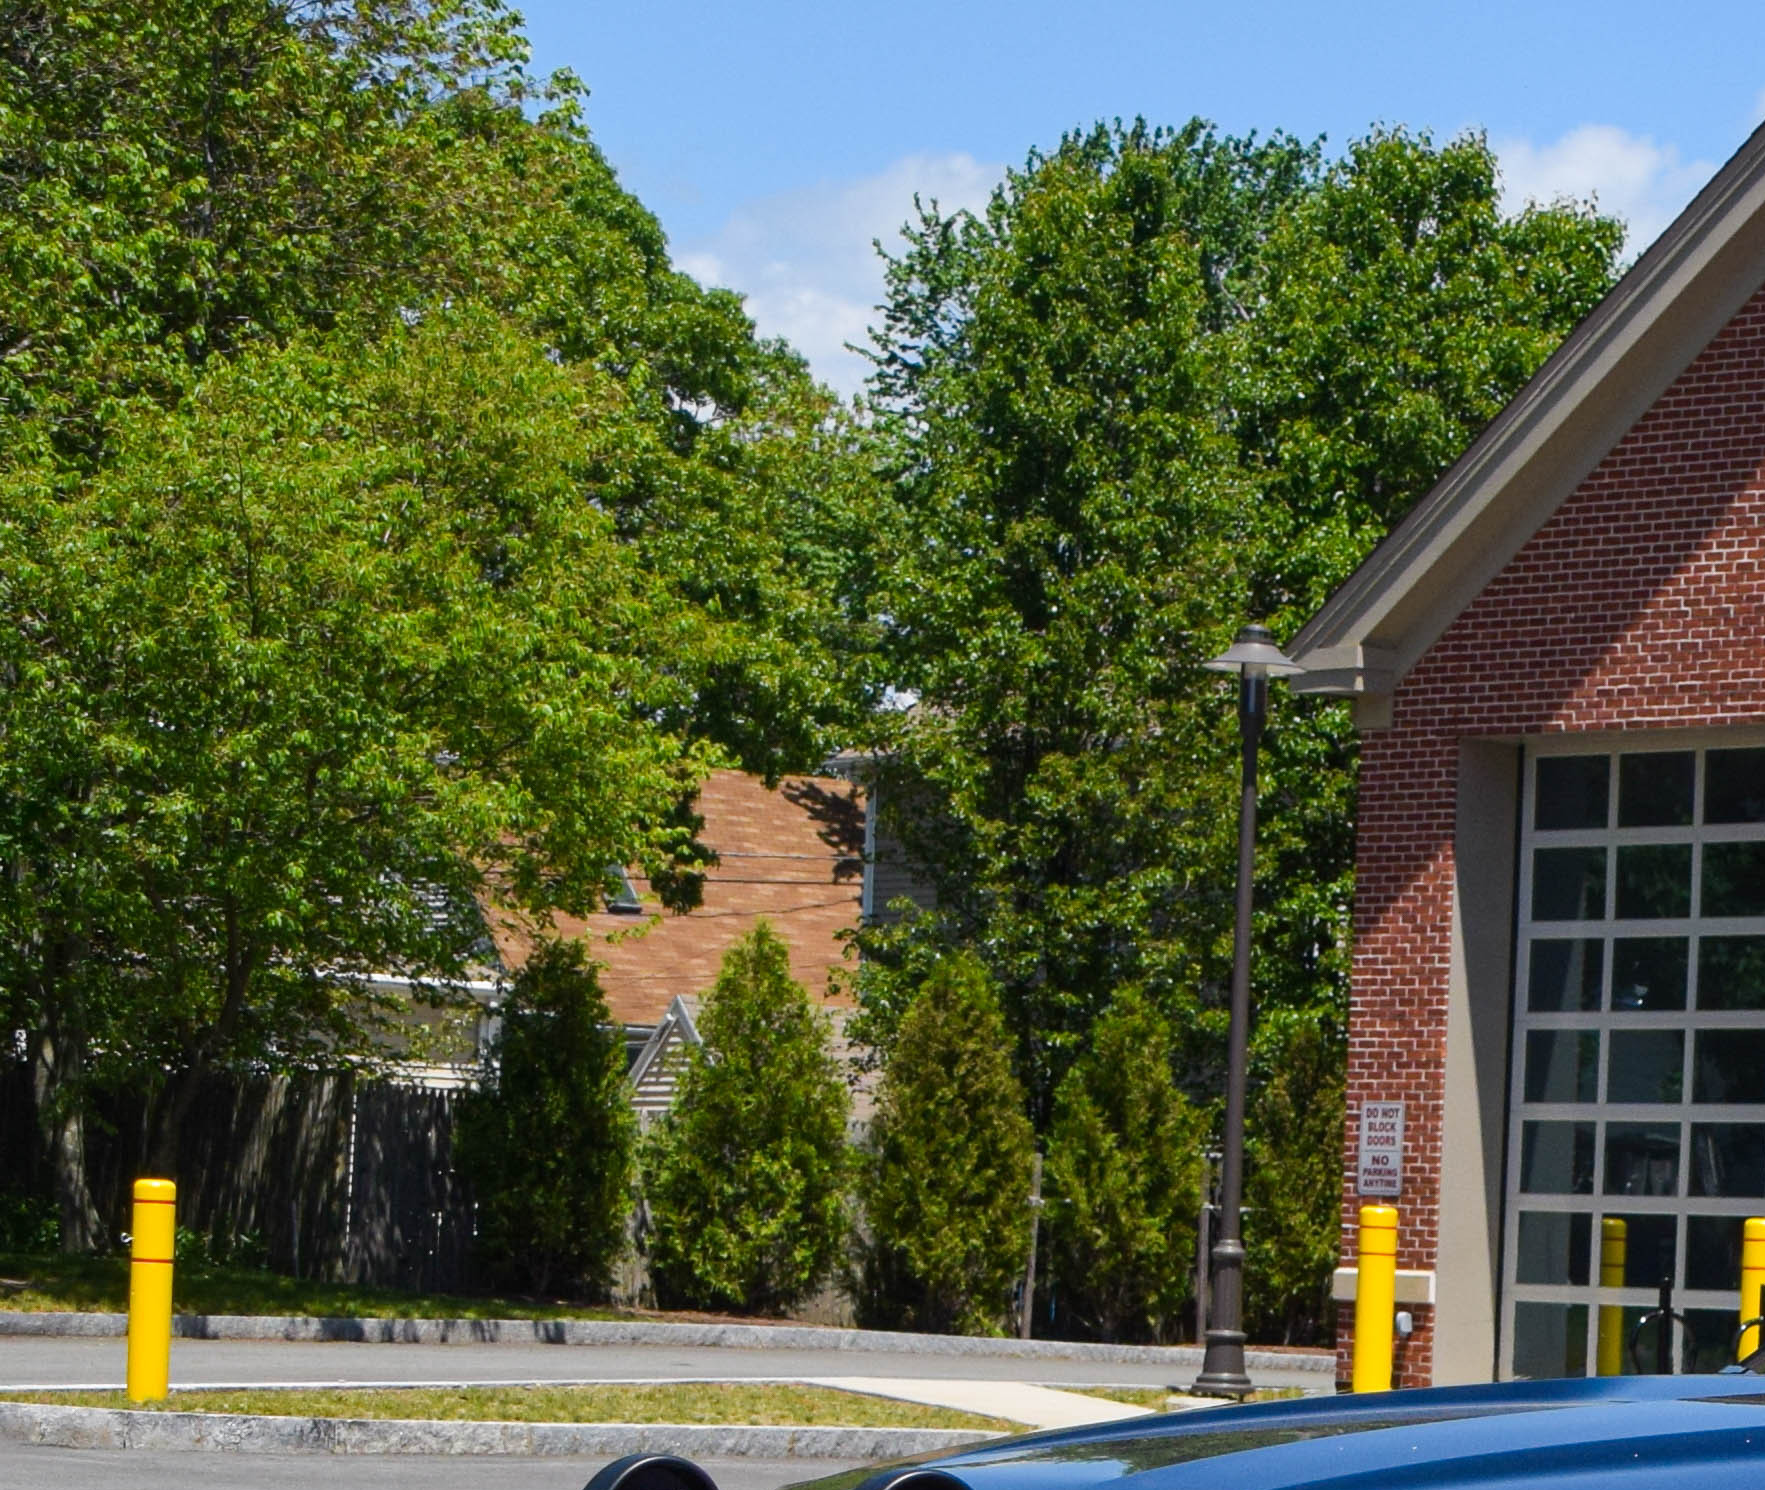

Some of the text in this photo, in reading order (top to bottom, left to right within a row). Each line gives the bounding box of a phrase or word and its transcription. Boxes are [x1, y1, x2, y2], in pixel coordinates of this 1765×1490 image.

[1366, 1108, 1400, 1118] DO NOT
[1368, 1122, 1396, 1132] BLOCK
[1367, 1136, 1396, 1146] DOORS
[1371, 1155, 1389, 1166] NO
[1363, 1168, 1397, 1177] PARKING
[1363, 1179, 1397, 1188] ANYTIME
